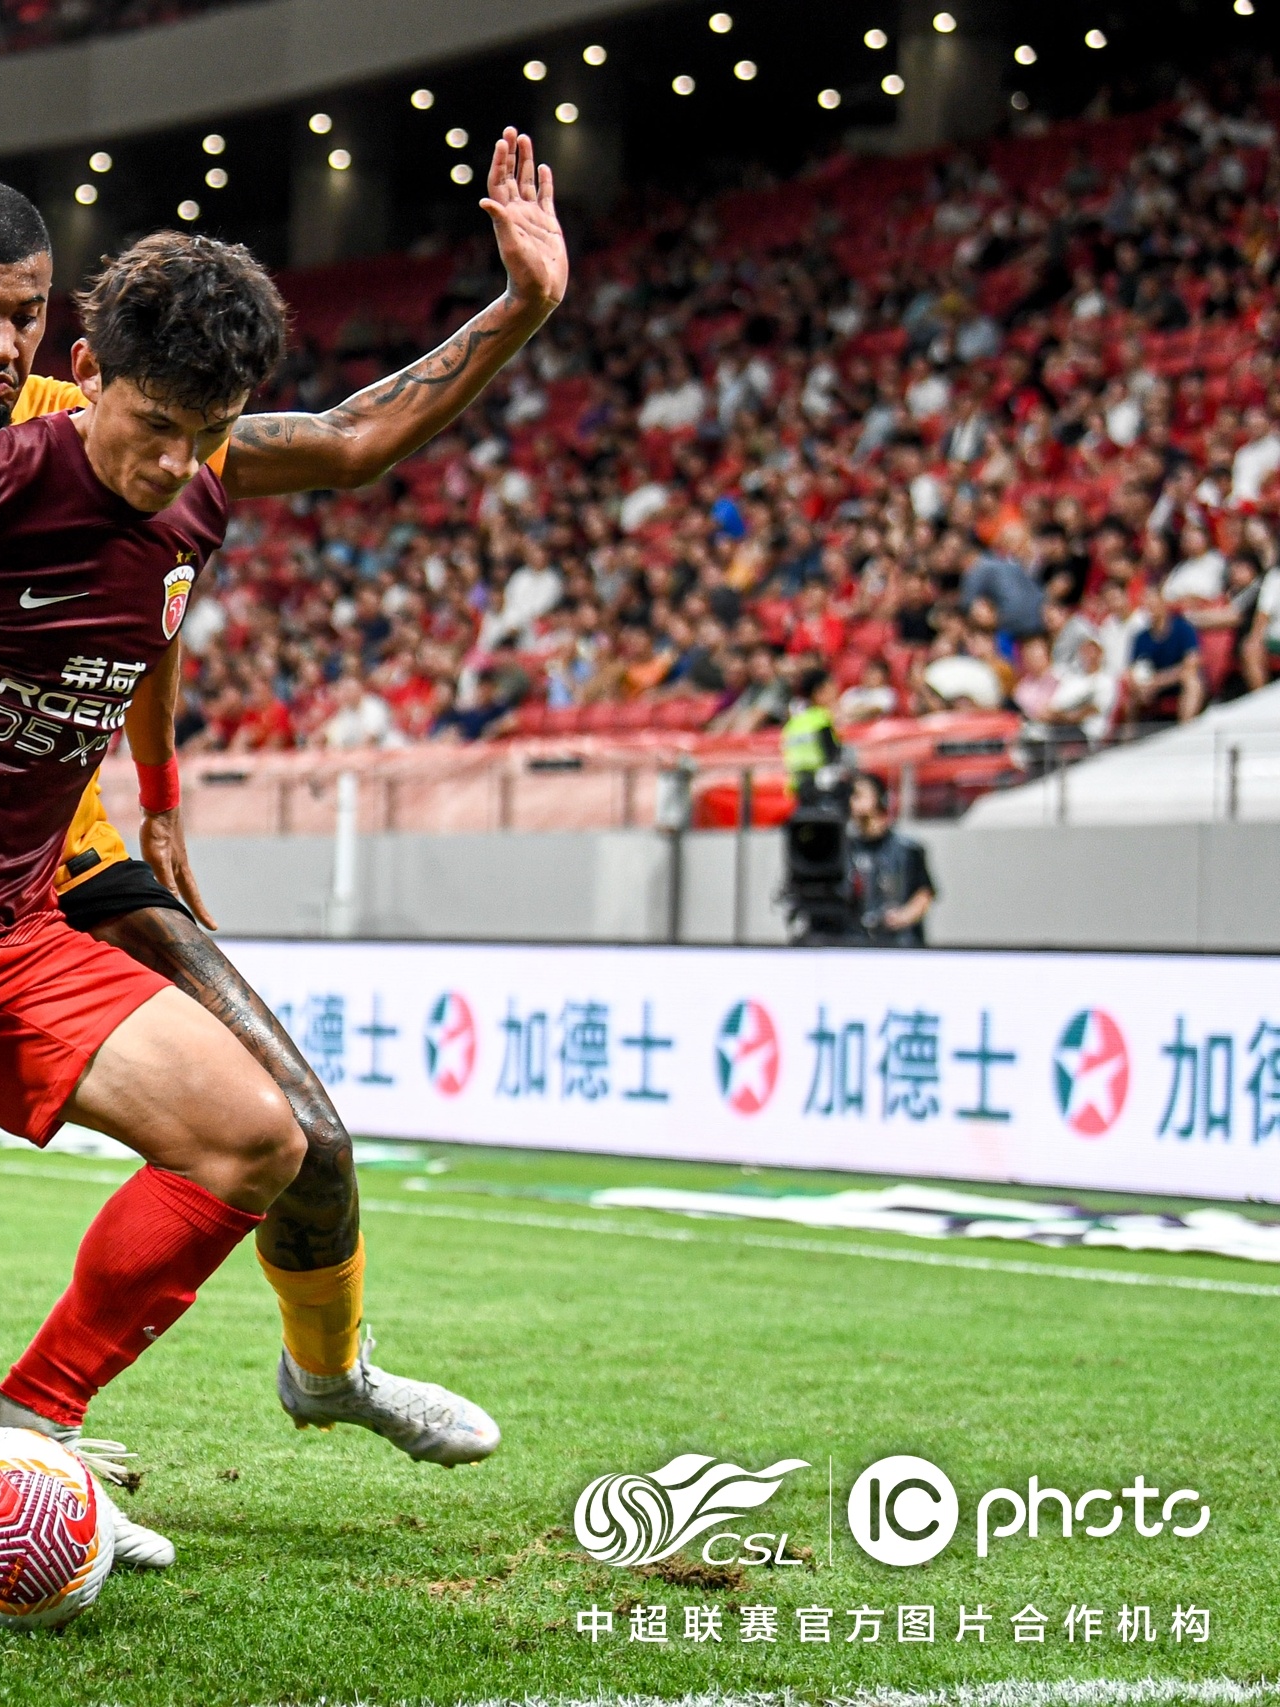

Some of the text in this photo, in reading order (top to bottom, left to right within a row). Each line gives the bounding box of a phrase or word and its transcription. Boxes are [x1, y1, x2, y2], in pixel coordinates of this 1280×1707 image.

[60, 655, 147, 695] 荣威
[496, 994, 672, 1103] 加德士
[803, 1003, 1017, 1123] 加德士
